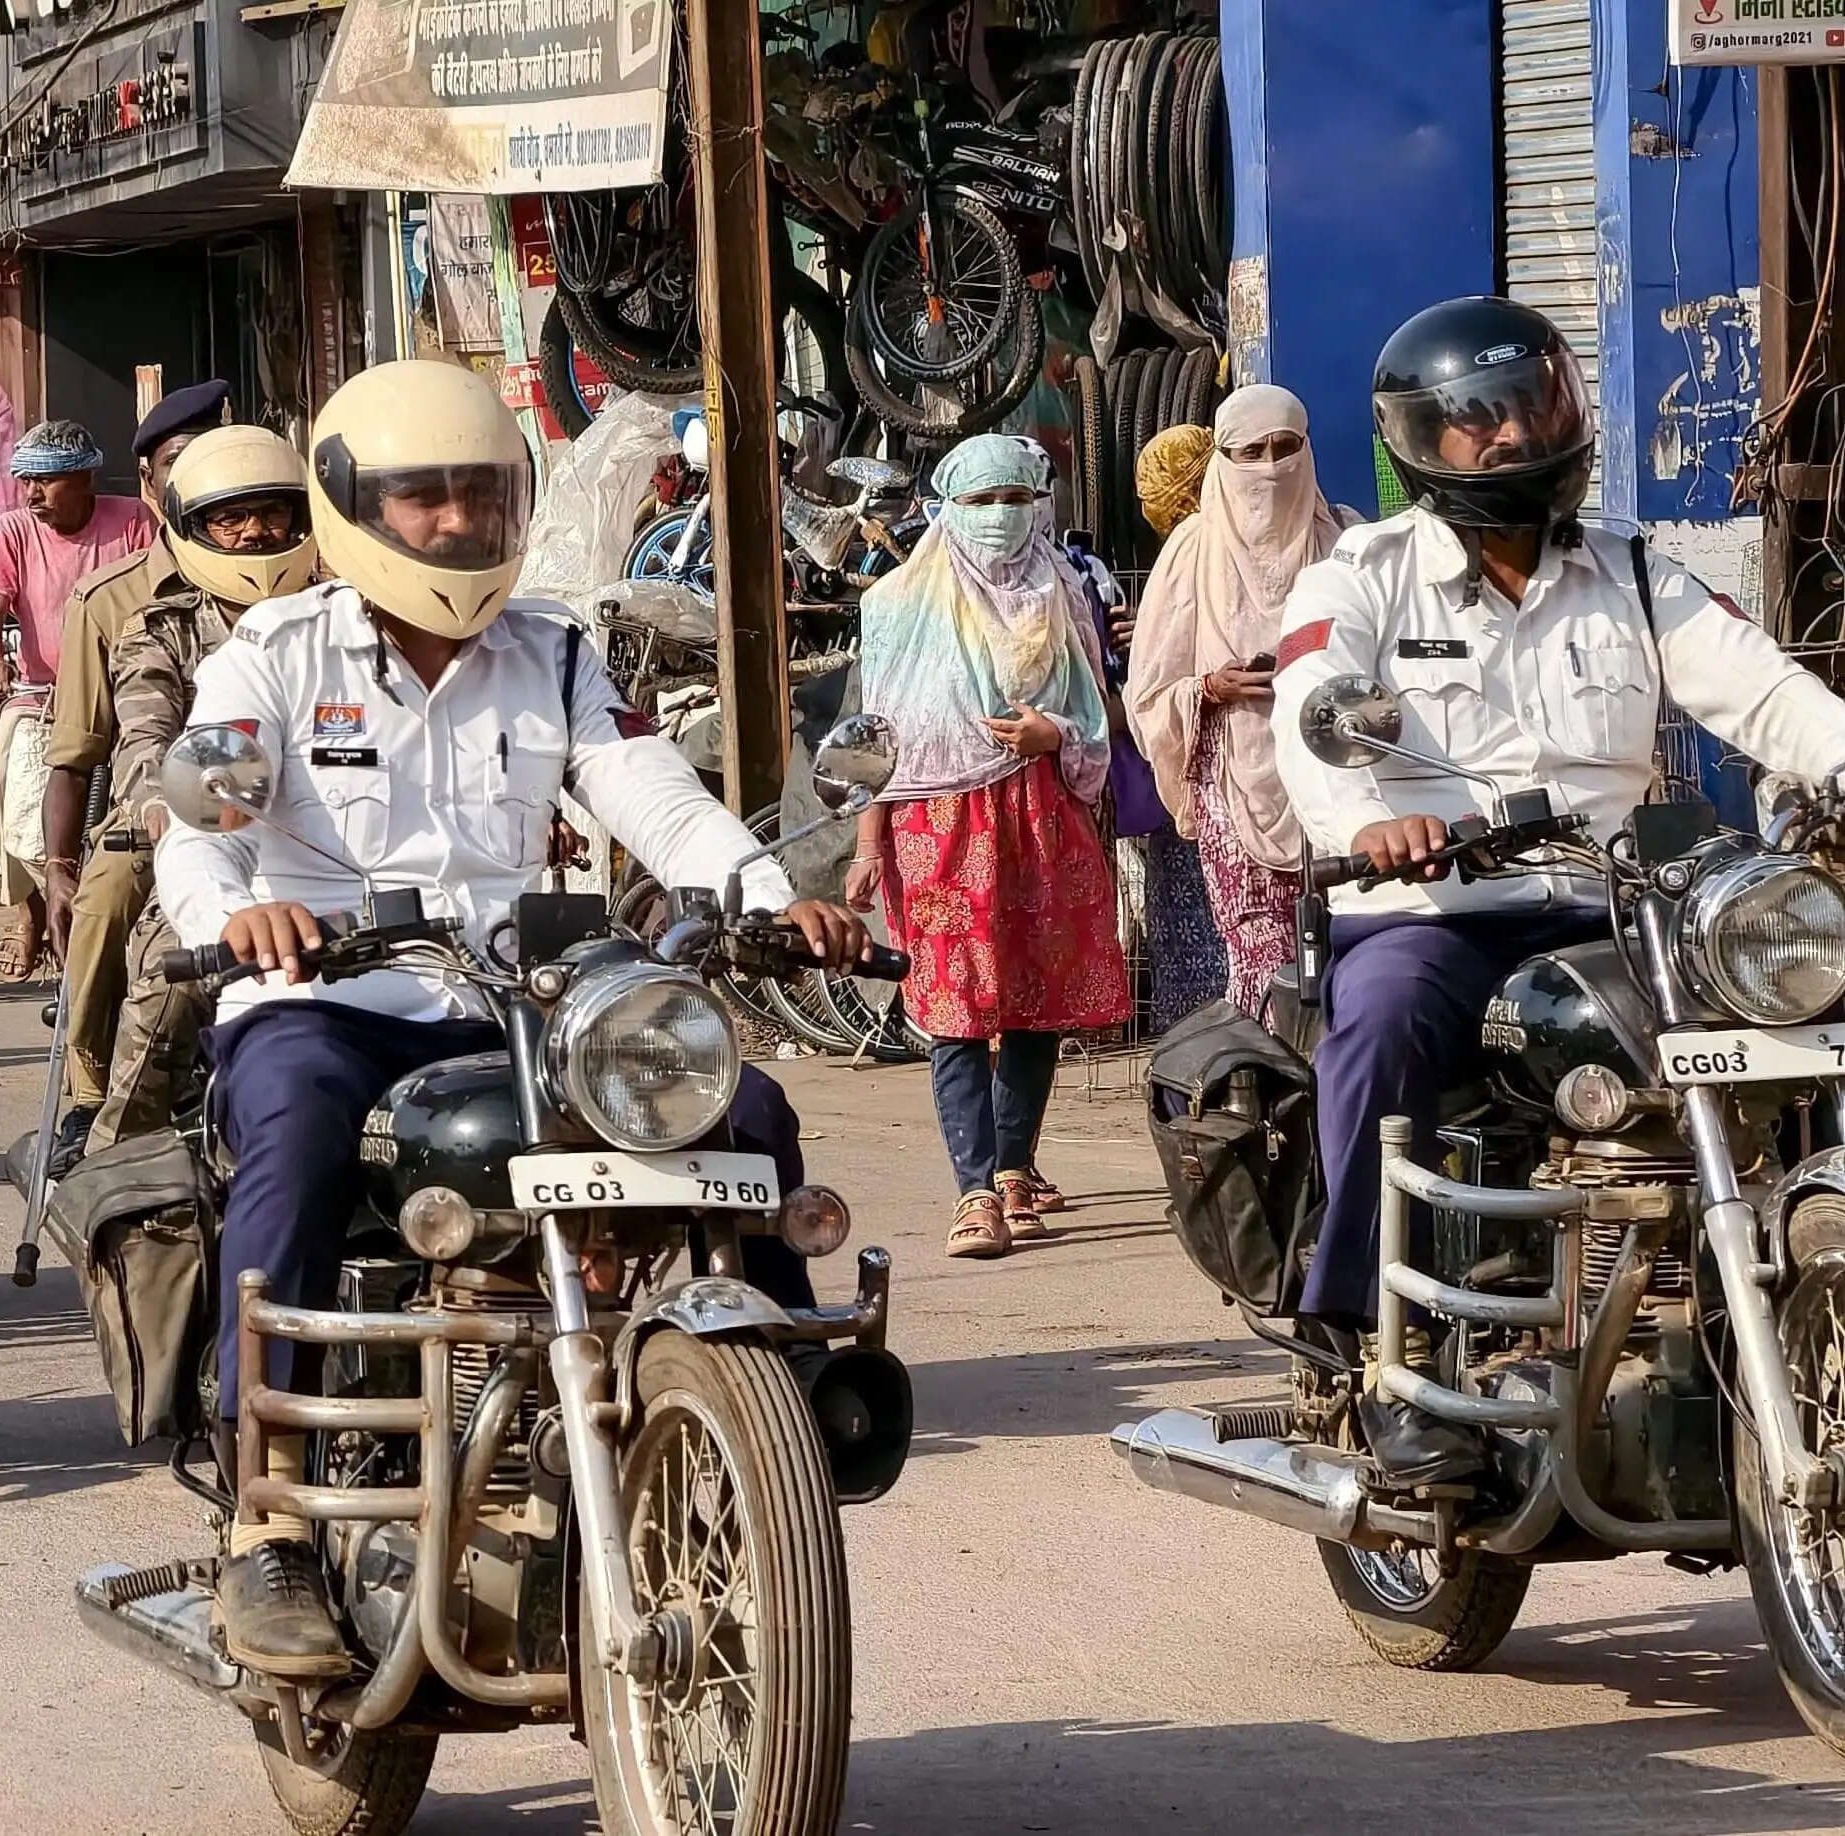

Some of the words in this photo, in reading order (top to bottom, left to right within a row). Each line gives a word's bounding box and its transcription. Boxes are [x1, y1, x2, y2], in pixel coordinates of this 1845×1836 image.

[1709, 31, 1812, 49] /aghormarg2021
[991, 155, 1061, 183] BALWAN
[1672, 1052, 1747, 1075] CG03
[533, 1184, 574, 1203] CG
